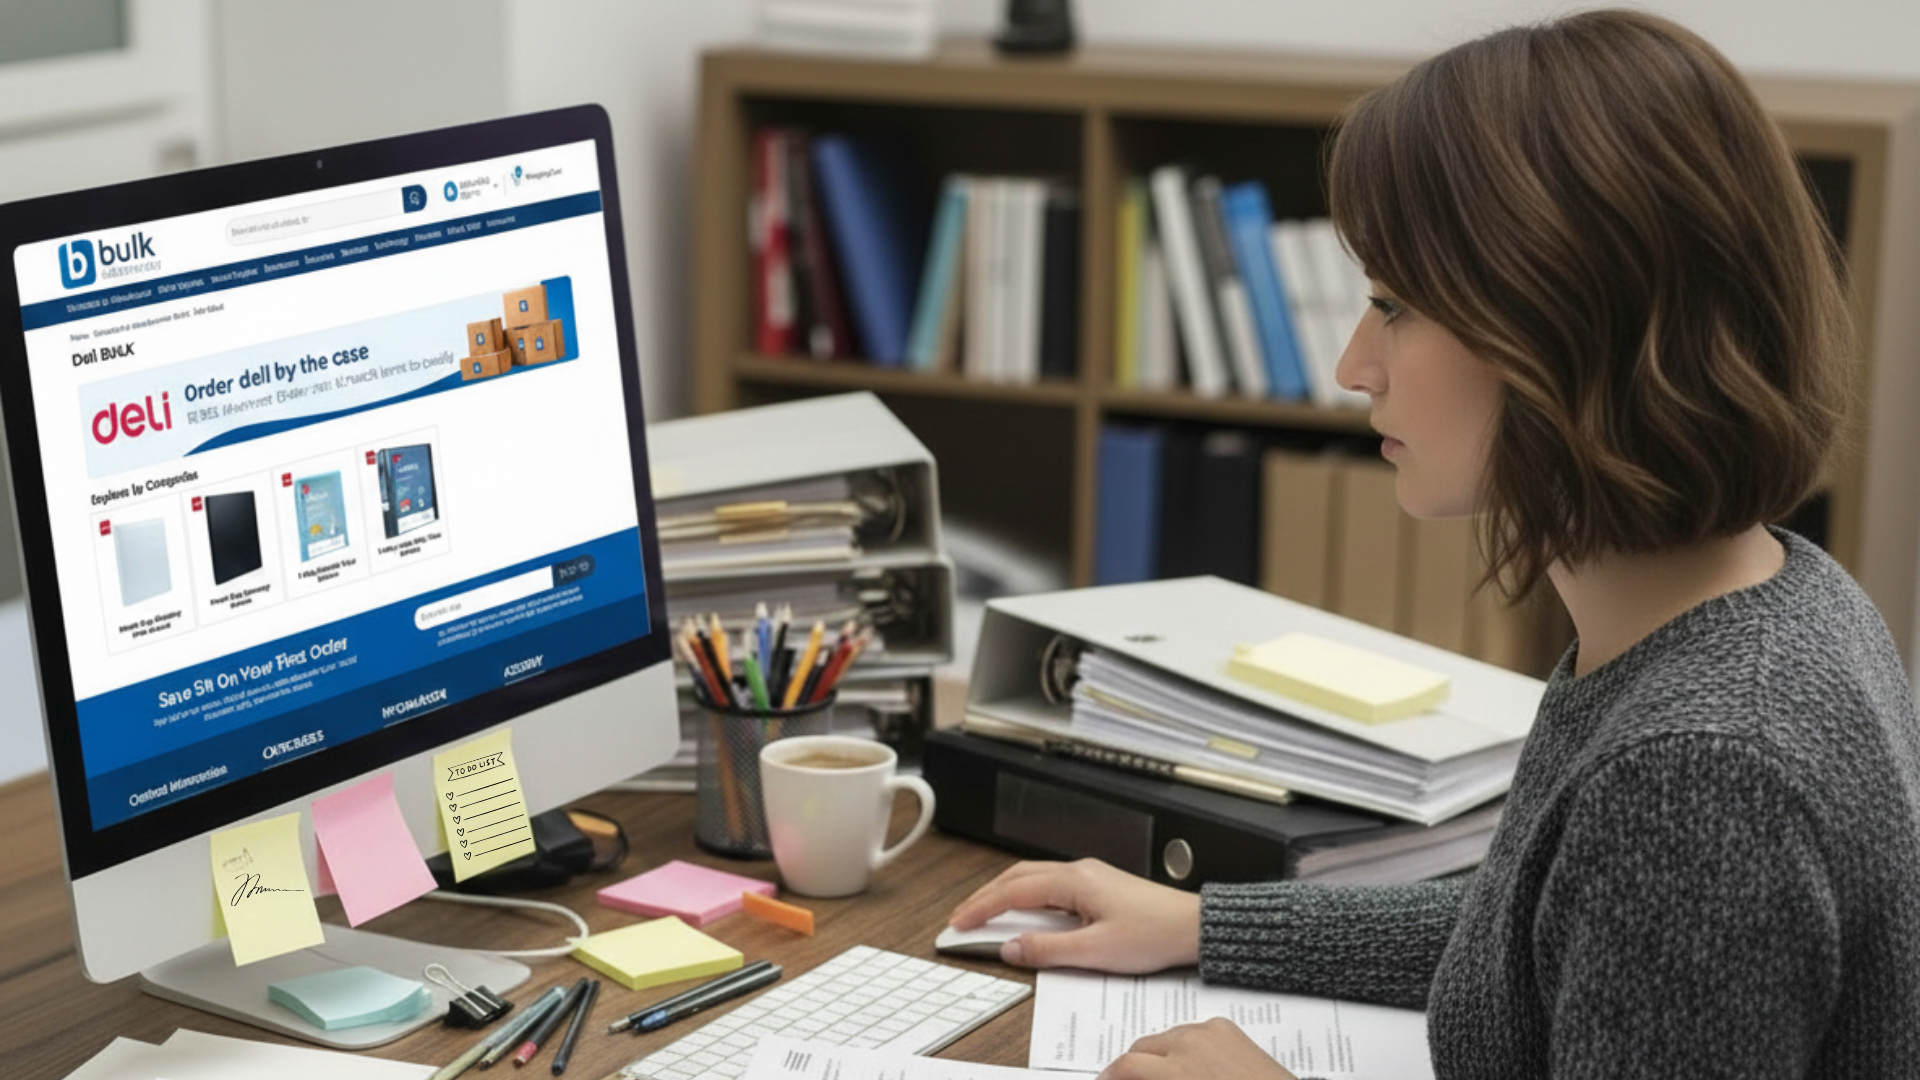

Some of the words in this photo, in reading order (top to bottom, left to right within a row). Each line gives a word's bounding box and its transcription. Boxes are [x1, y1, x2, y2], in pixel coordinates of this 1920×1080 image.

[98, 231, 156, 266] bulk
[184, 377, 234, 402] Order
[239, 363, 271, 390] dell
[274, 361, 297, 383] by
[300, 353, 329, 375] the
[91, 390, 173, 446] deli
[216, 672, 240, 690] On
[454, 767, 466, 777] TO
[467, 763, 478, 773] DO
[479, 757, 496, 769] LIST
